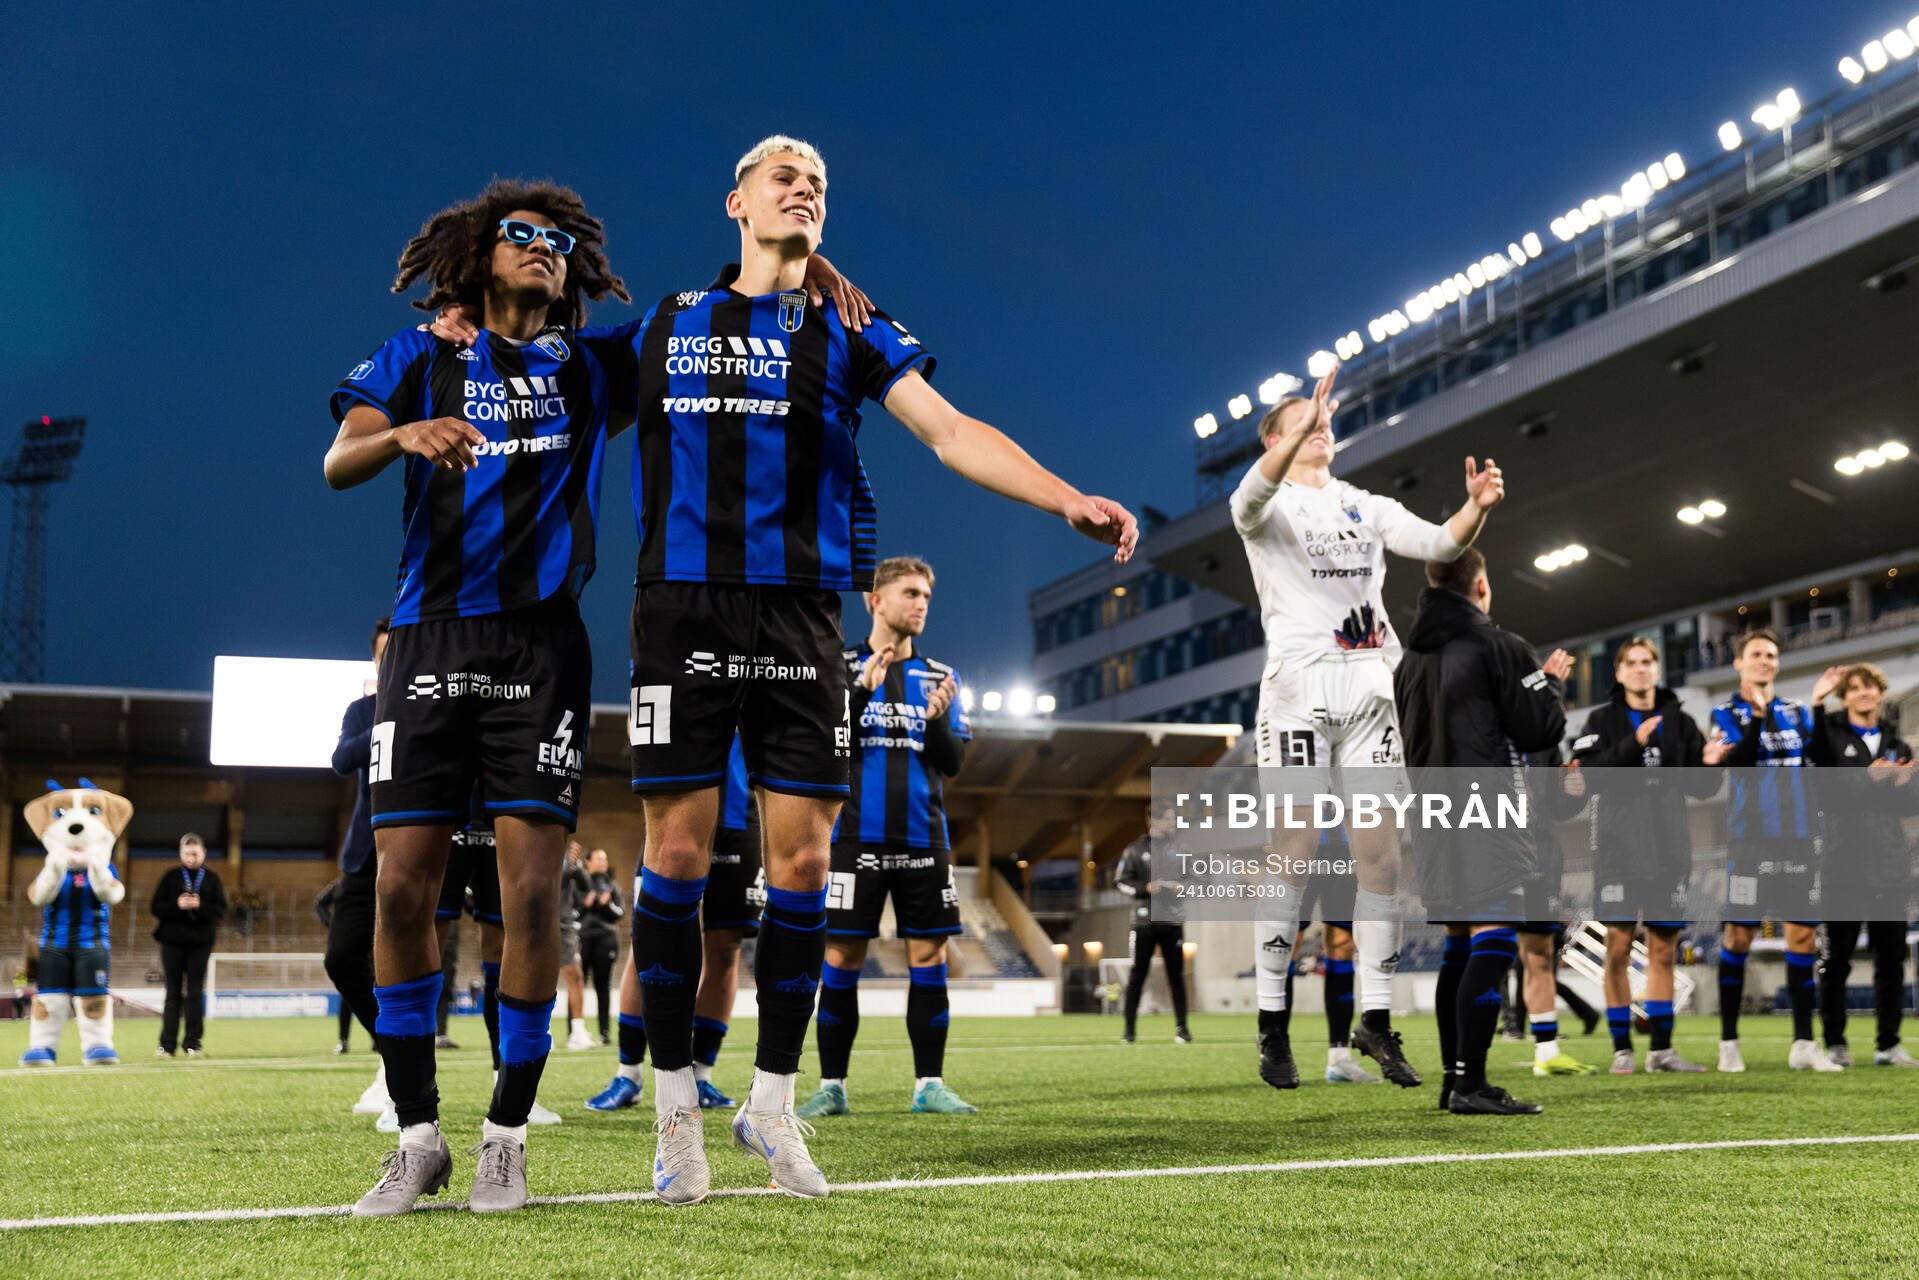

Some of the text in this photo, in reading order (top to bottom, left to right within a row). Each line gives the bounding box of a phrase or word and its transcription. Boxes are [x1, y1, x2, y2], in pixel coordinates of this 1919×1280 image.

[667, 336, 722, 355] BYGG
[665, 356, 792, 379] CONSTRUCT
[464, 380, 507, 400] BYG
[463, 397, 566, 421] CONTRUCT
[662, 397, 791, 416] TOYO TIRES
[470, 439, 519, 456] OYO
[447, 682, 531, 700] BILFORUM
[864, 701, 894, 715] YGG
